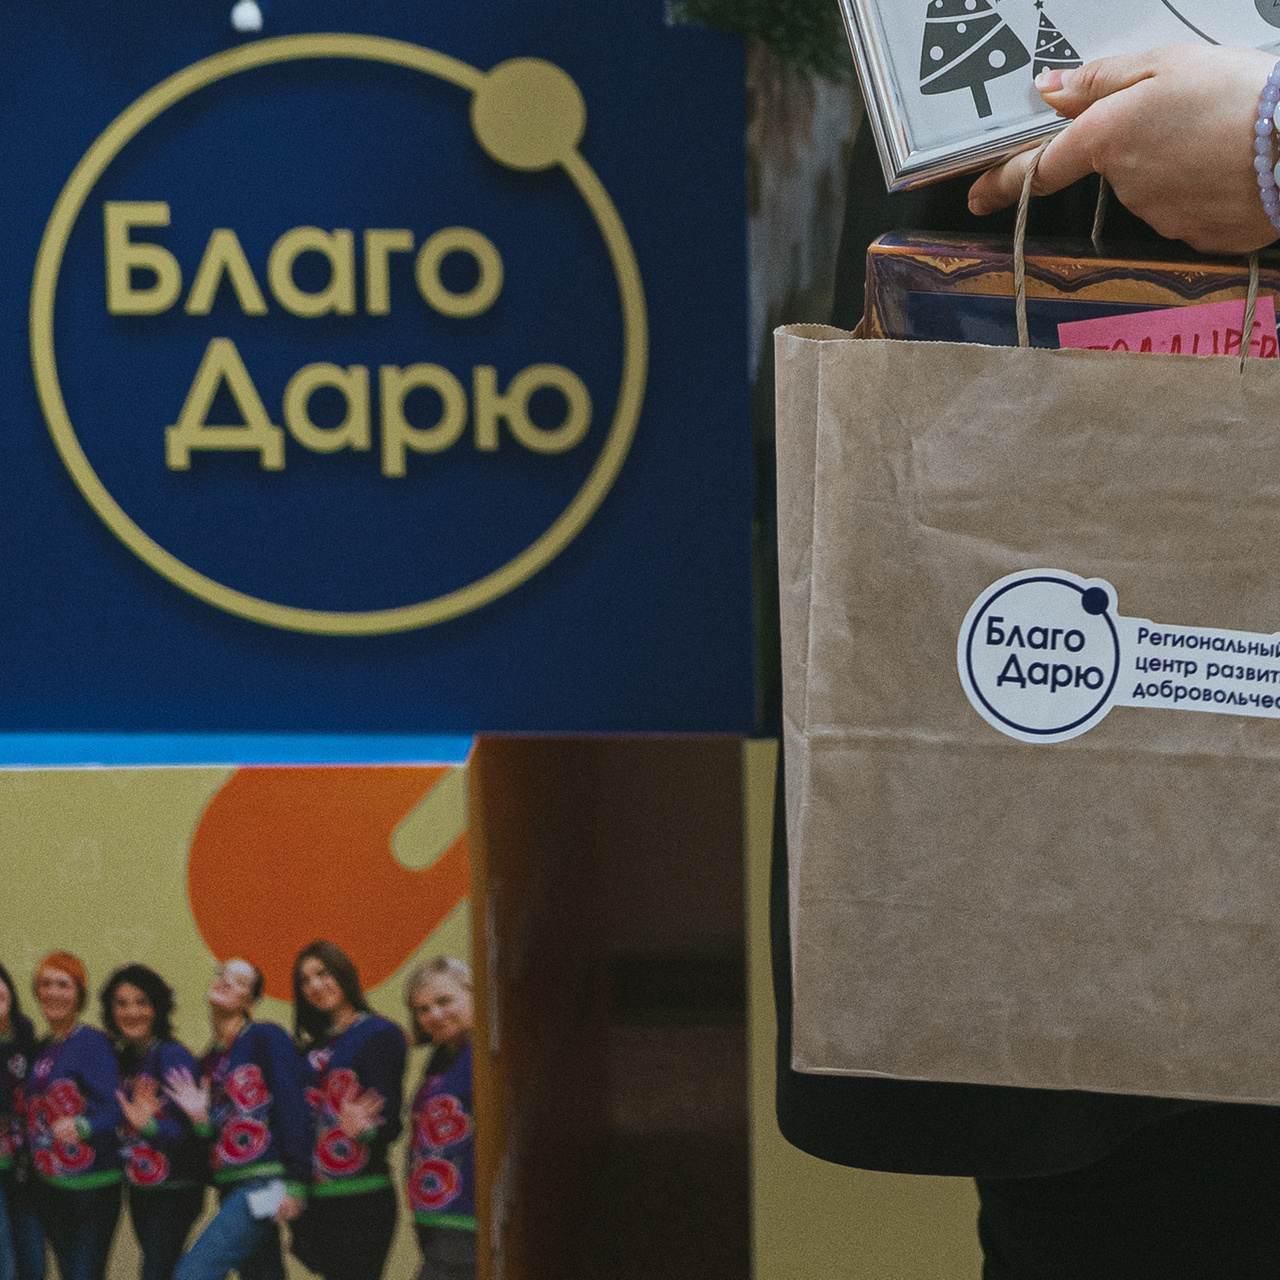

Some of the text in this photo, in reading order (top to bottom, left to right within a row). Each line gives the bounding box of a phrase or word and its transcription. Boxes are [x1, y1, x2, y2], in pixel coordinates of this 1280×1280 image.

[103, 201, 504, 318] Благо
[164, 338, 593, 478] Дарю
[985, 615, 1087, 654] Благо
[996, 652, 1105, 692] Дарю
[1135, 654, 1199, 680] центр
